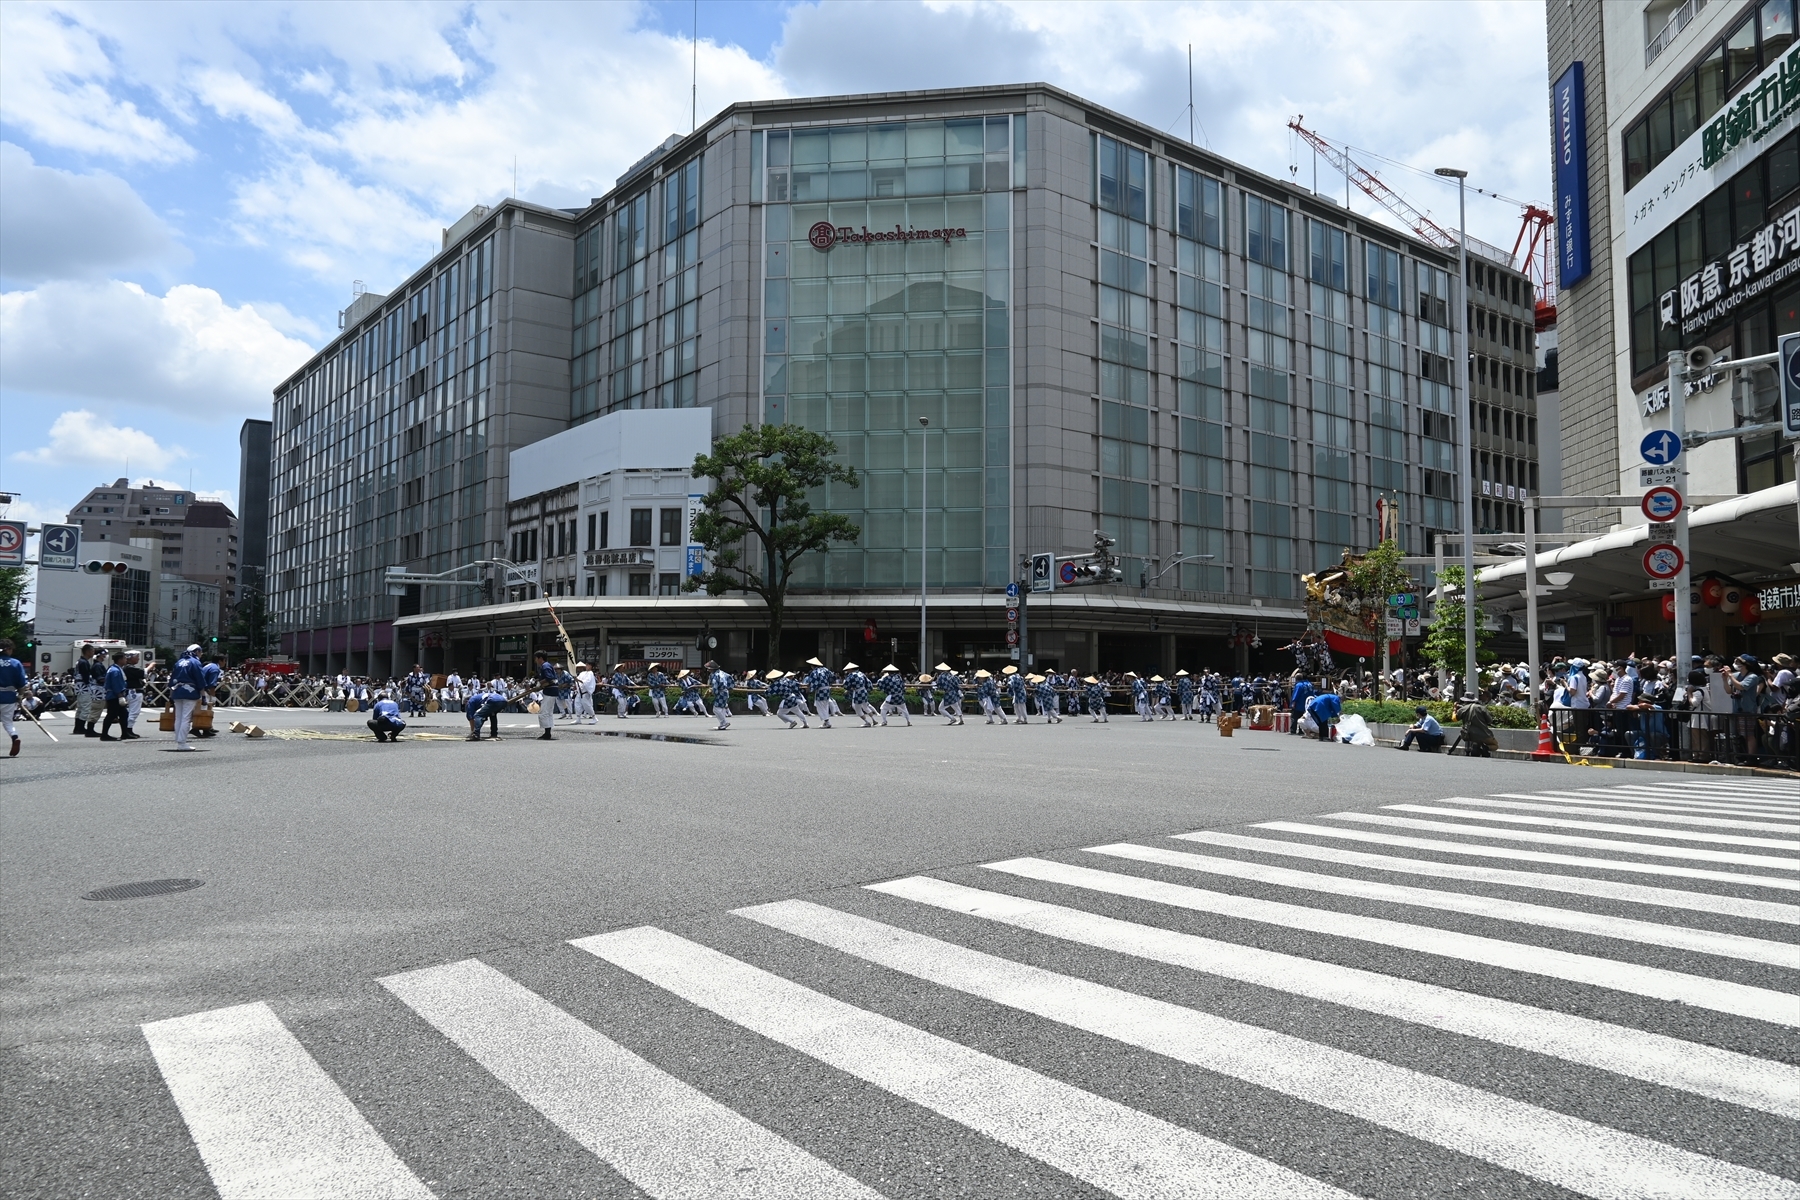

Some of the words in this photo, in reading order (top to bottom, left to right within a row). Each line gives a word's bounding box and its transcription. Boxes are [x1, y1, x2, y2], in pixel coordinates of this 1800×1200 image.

[1561, 85, 1572, 165] MIZUHO
[837, 224, 967, 244] Takashimaya
[1564, 194, 1574, 270] みずほ銀行
[1682, 307, 1714, 336] Hankyu
